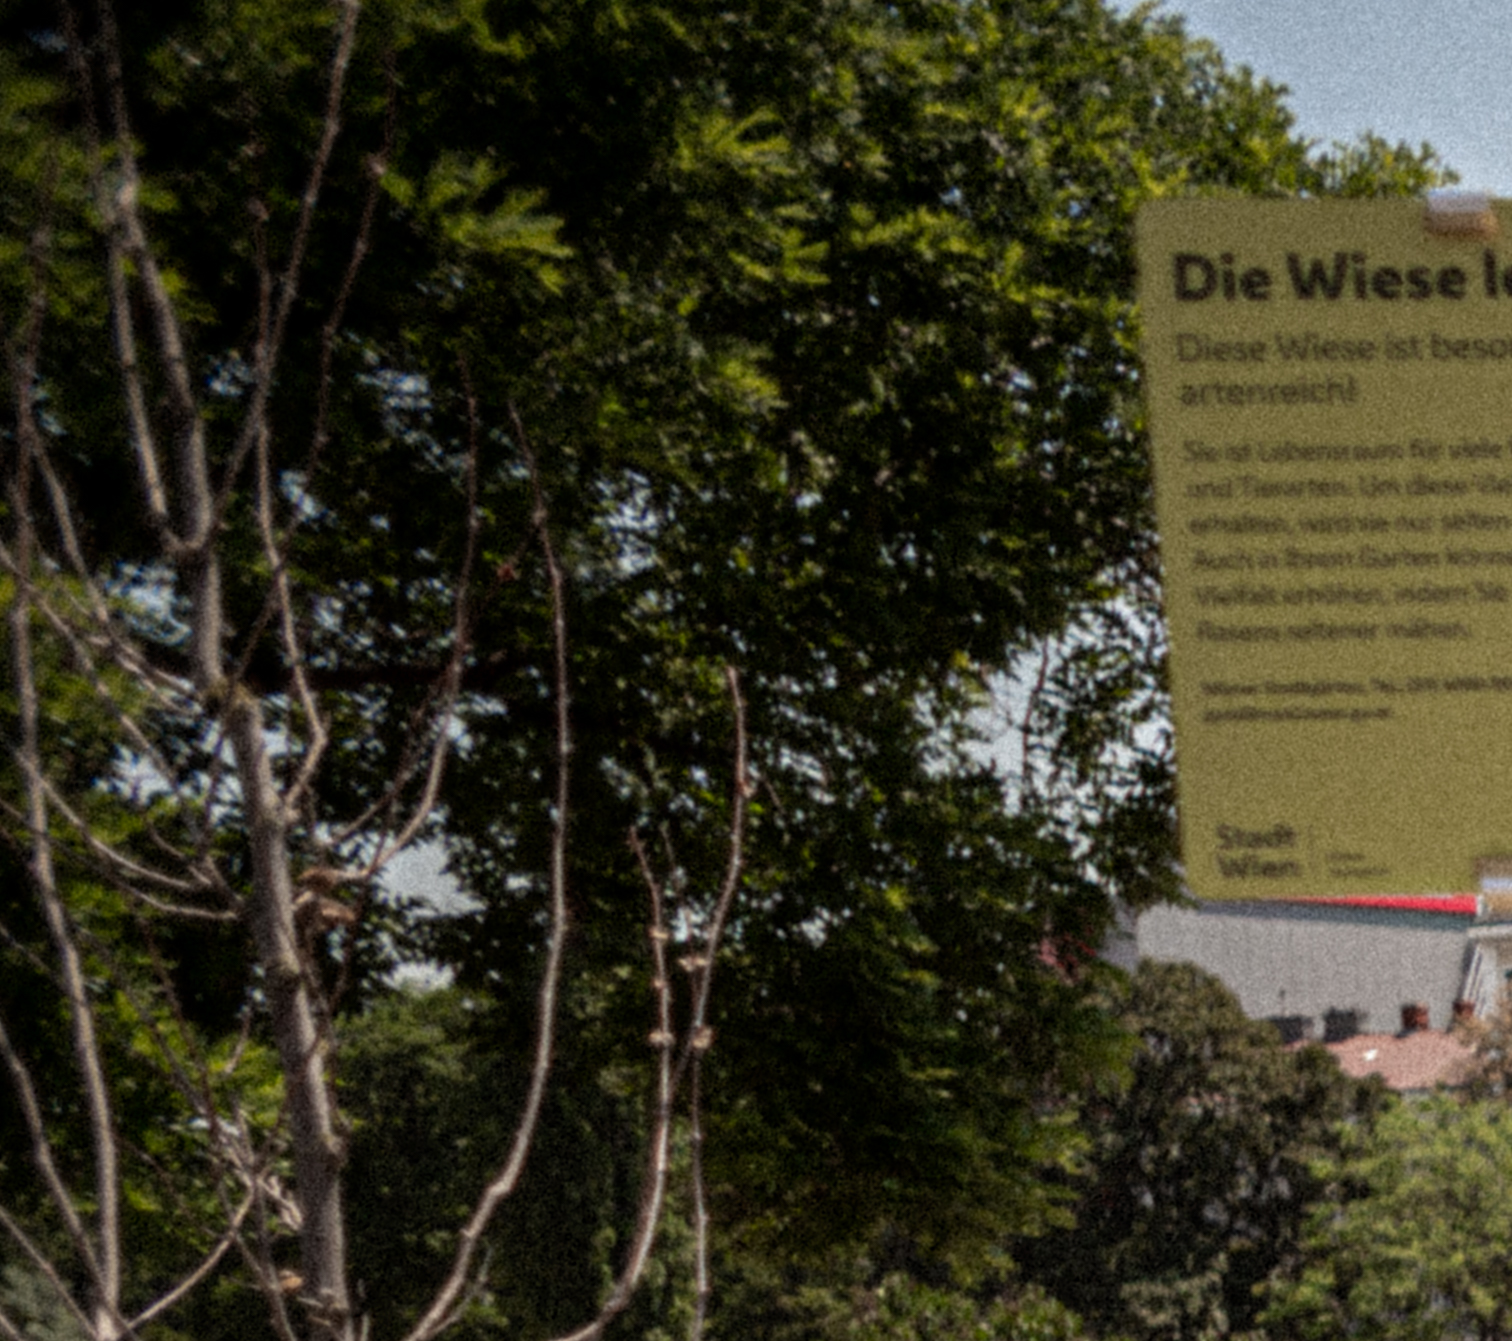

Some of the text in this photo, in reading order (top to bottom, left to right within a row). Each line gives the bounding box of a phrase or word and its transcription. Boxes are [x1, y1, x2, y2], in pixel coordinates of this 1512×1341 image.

[1172, 253, 1271, 302] Die
[1287, 251, 1467, 301] Wiese
[1176, 332, 1267, 363] Diese
[1274, 331, 1376, 362] Wiese
[1384, 331, 1425, 360] ist
[1216, 822, 1296, 849] Stadt
[1216, 853, 1303, 880] Wien
